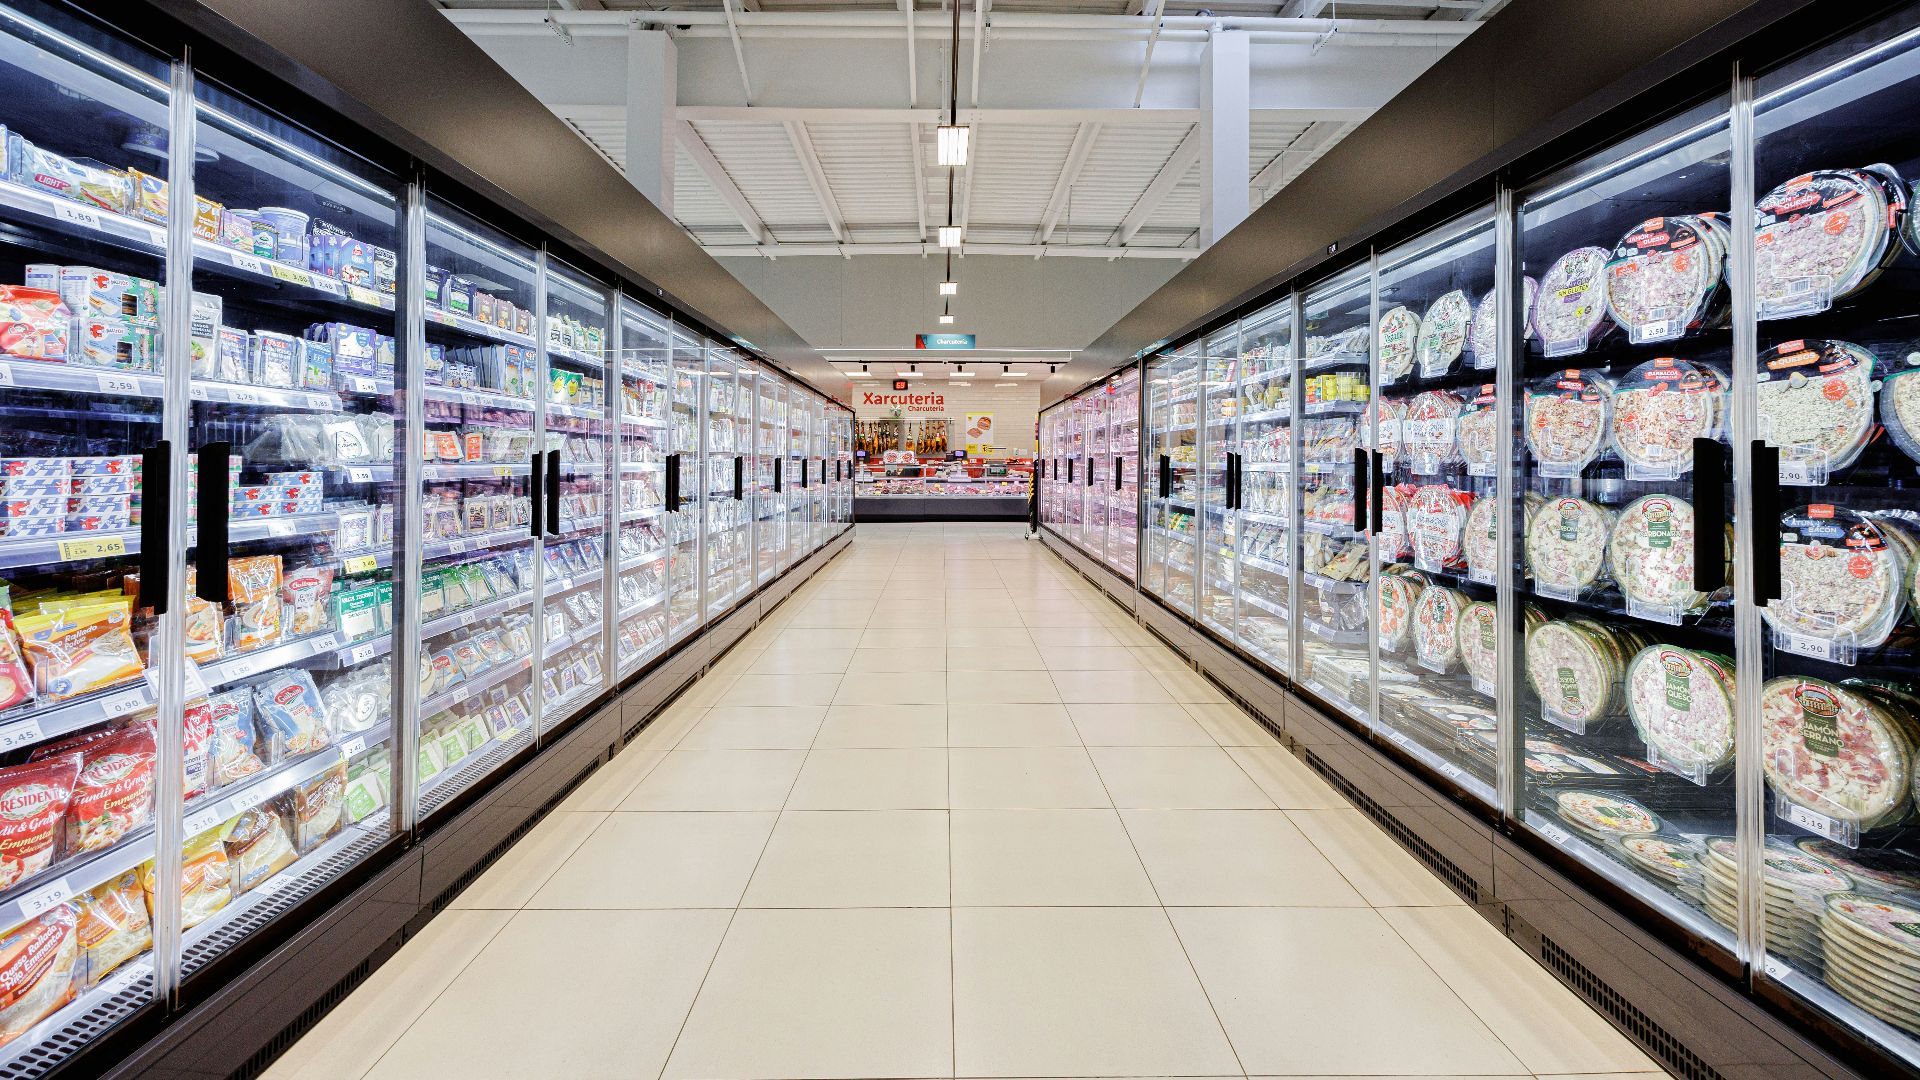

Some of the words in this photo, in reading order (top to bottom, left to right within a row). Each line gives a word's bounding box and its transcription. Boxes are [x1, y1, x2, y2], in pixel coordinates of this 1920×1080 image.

[38, 175, 61, 189] LIGHT
[1779, 351, 1817, 366] QUESOS
[109, 381, 132, 391] 2,59
[863, 391, 944, 405] Xarcuteria
[96, 543, 121, 554] 2,65
[65, 625, 97, 642] Rallado
[1800, 642, 1823, 653] 2,90
[115, 700, 140, 713] 0,90
[1804, 721, 1840, 738] JAMÓN
[4, 731, 34, 745] 3,45
[1799, 729, 1845, 748] SERRANO
[1801, 815, 1823, 830] 3,19
[33, 891, 62, 910] 3,19
[1, 955, 27, 982] Queso
[28, 925, 57, 956] Rallado
[24, 927, 63, 971] Emmental
